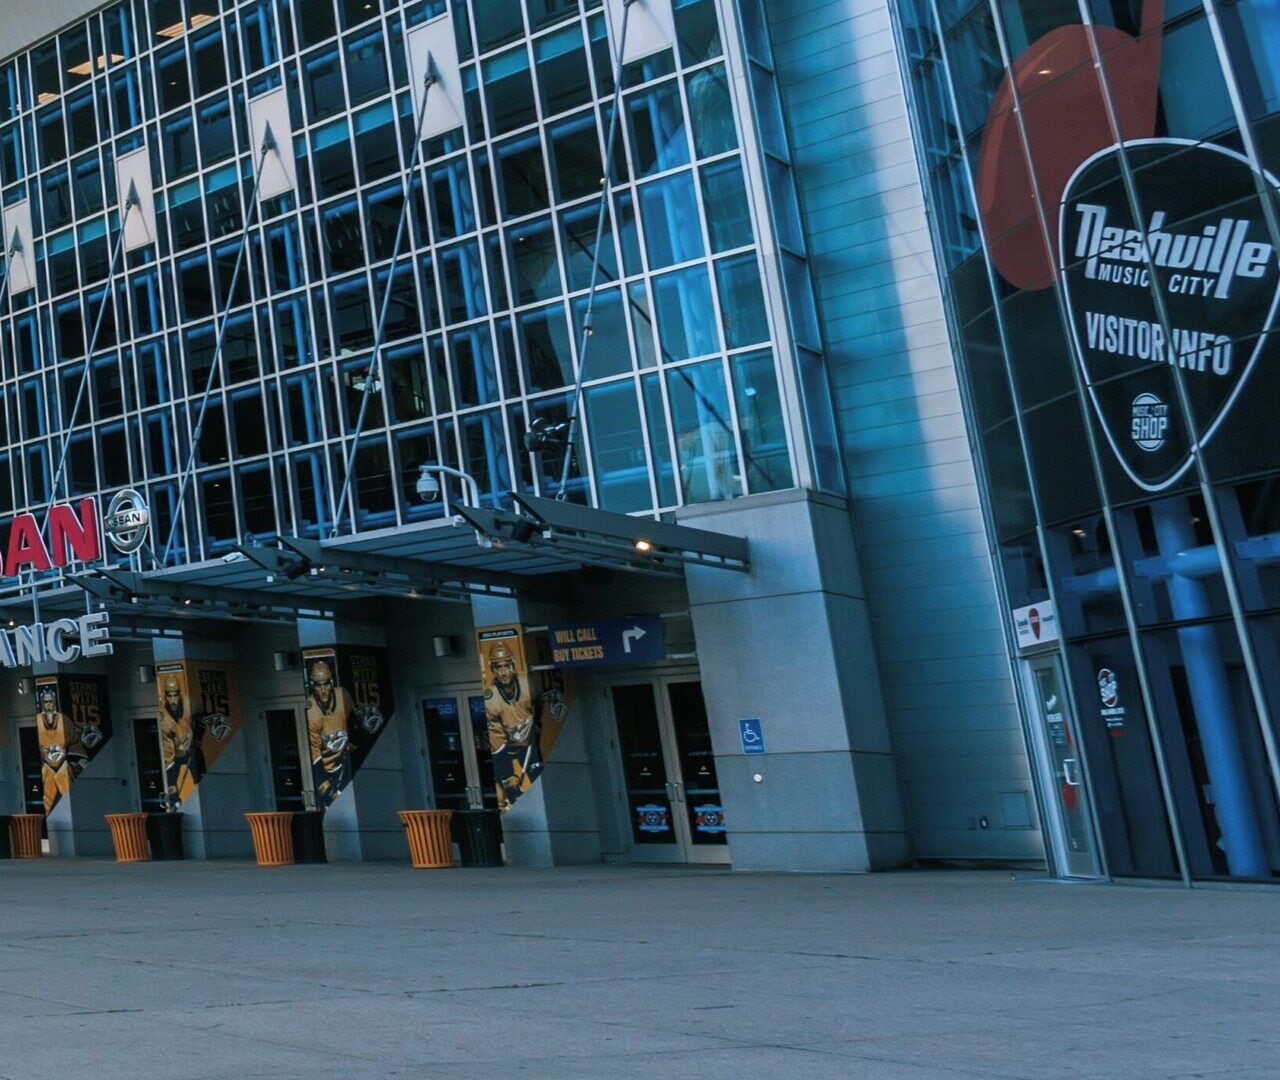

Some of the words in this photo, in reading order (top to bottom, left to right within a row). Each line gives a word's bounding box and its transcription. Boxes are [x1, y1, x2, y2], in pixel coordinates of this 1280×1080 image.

[1098, 263, 1150, 288] MUSIC
[1168, 274, 1216, 297] CITY
[1085, 311, 1165, 362] VISITOR
[1168, 328, 1232, 376] INFO
[1131, 416, 1168, 440] SHOP
[554, 630, 576, 643] WILL
[576, 628, 598, 642] CALL
[570, 645, 604, 660] TICKETS
